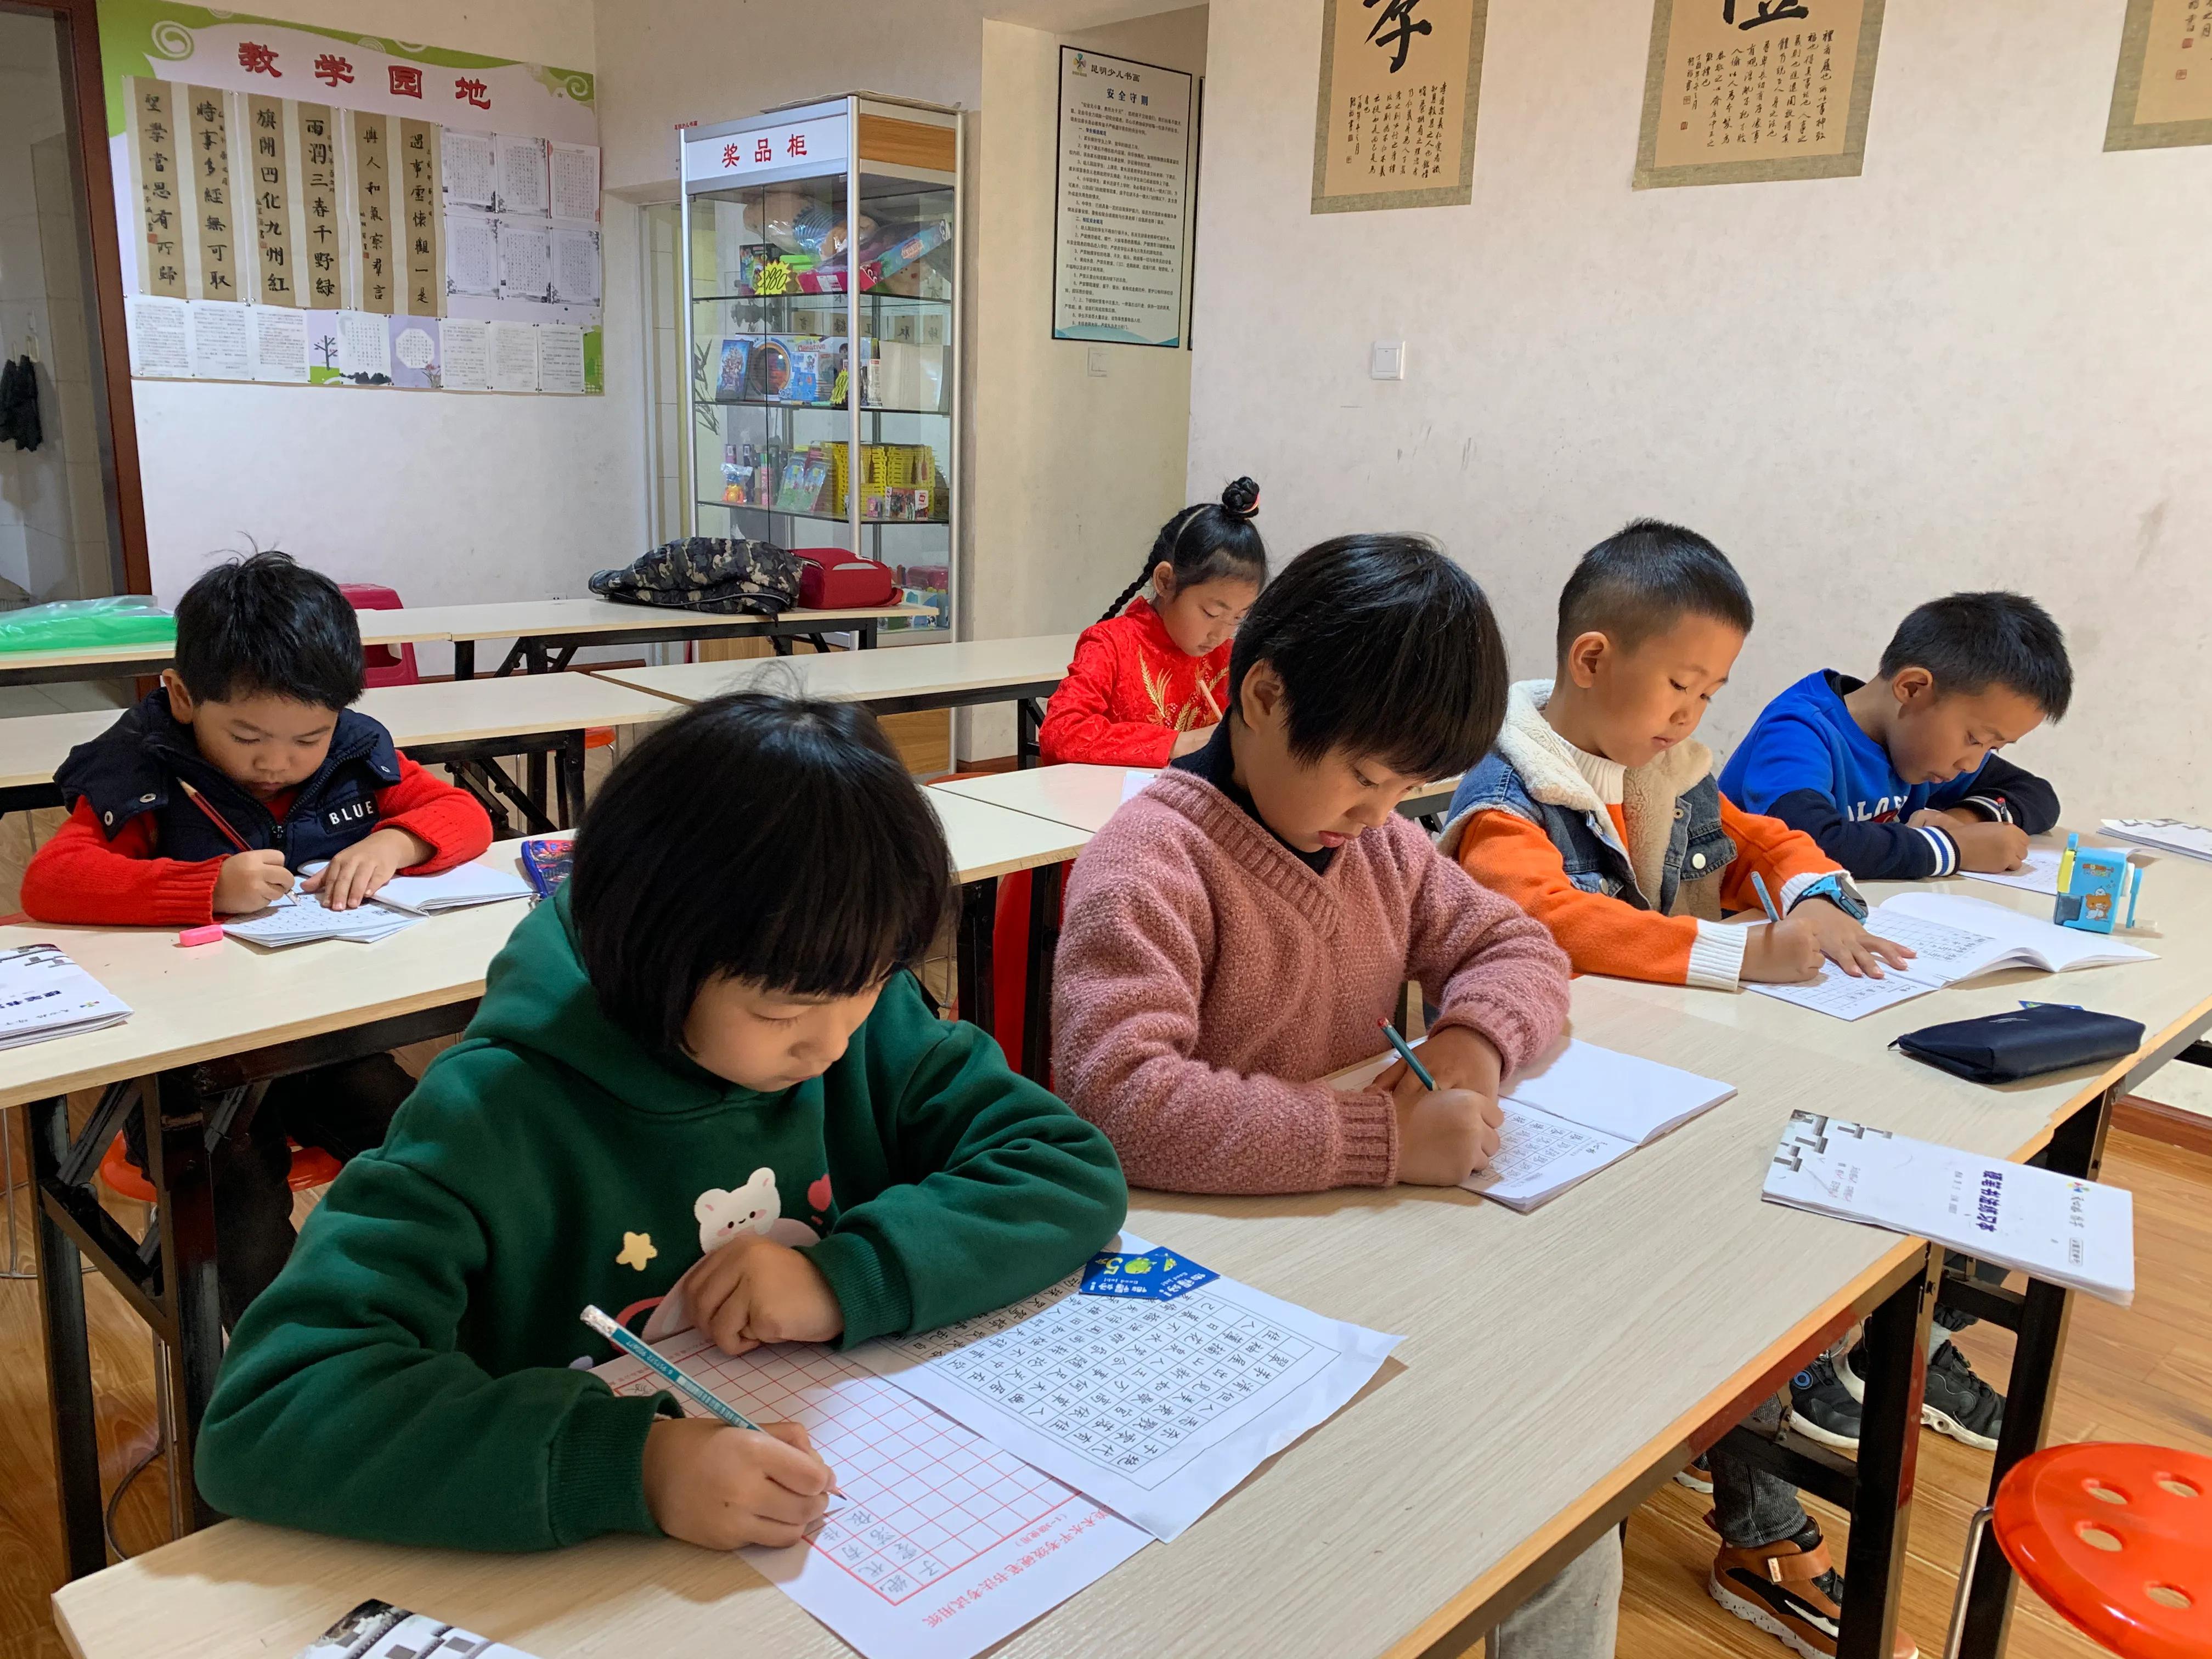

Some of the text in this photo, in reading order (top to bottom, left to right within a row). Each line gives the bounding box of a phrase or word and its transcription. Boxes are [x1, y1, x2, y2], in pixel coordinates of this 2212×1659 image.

[238, 40, 491, 110] 教学园地
[1091, 64, 1141, 82] 昆明少儿书画
[1107, 88, 1148, 106] 安全守则
[722, 133, 808, 168] 奖品柜
[329, 800, 374, 825] BLUE
[1975, 1170, 2004, 1232] 硬笔书法练习本
[1104, 1257, 1124, 1274] 5
